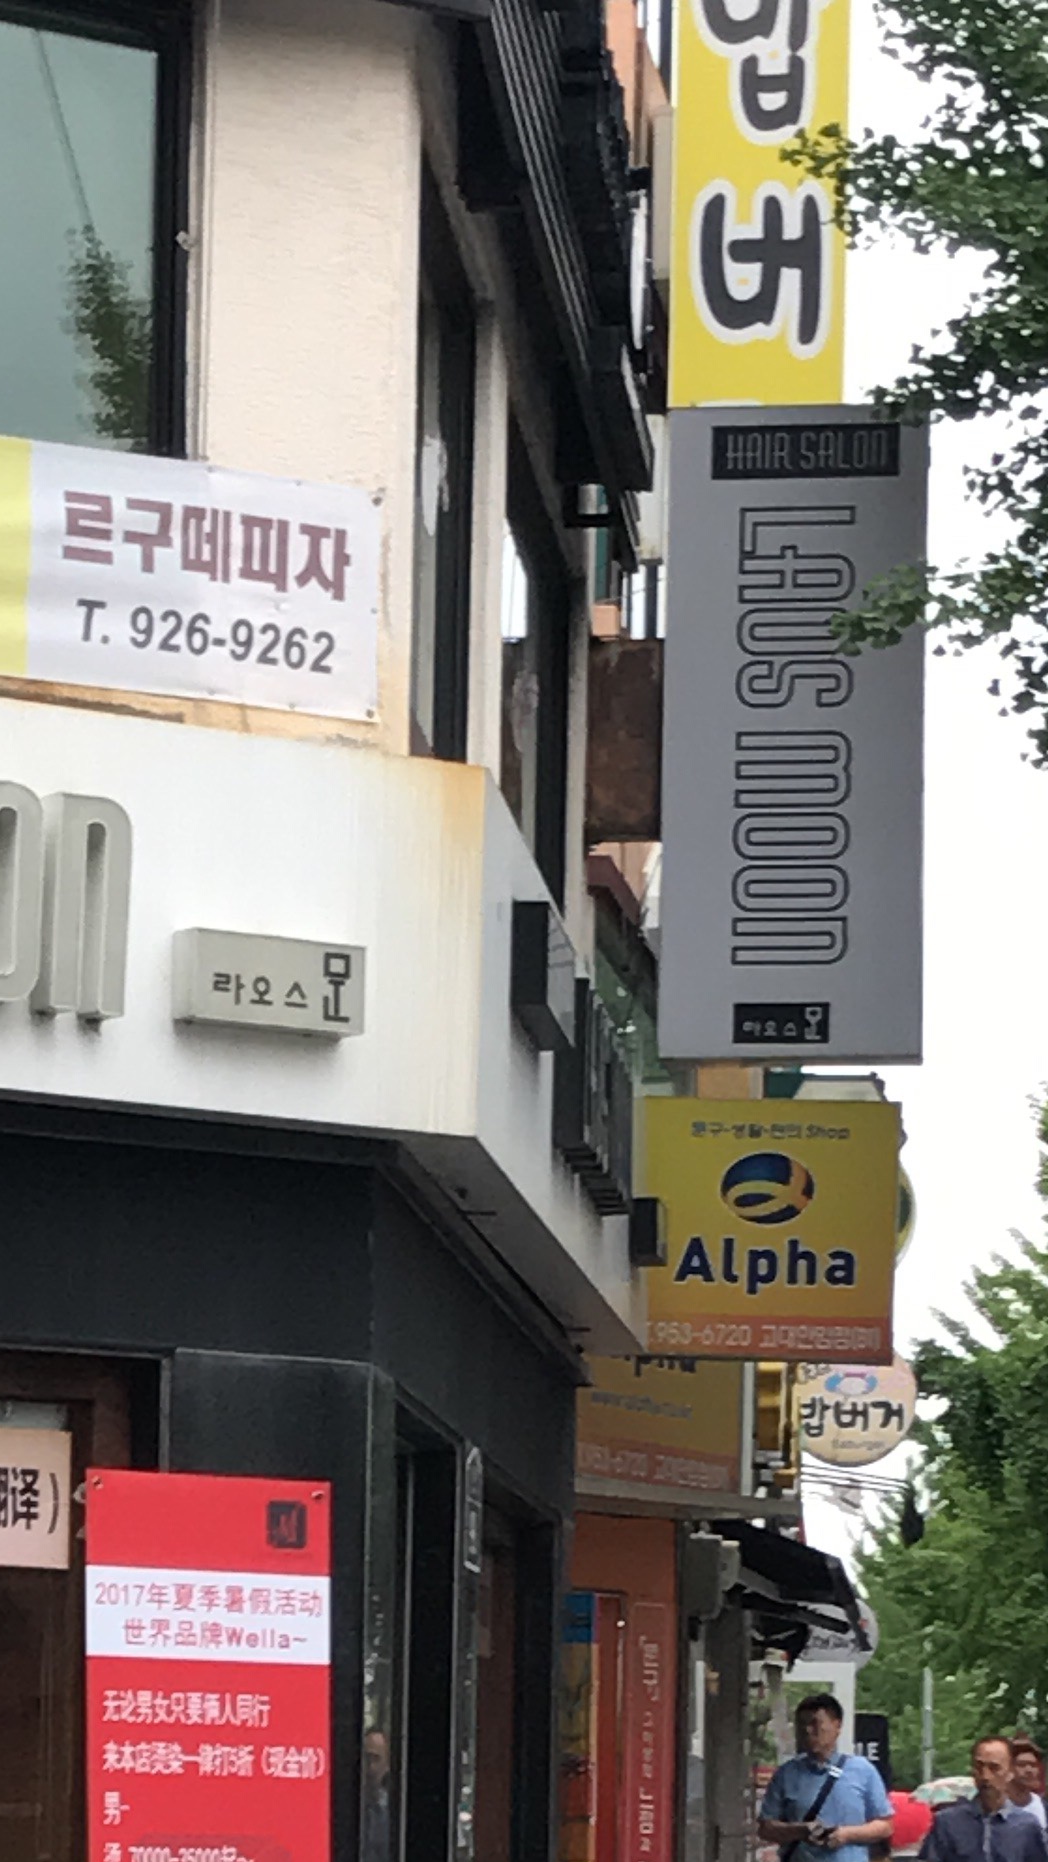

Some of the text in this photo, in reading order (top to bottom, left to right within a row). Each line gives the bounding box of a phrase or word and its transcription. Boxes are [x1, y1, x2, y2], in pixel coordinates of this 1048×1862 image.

[725, 430, 888, 471] HAIR SALON
[61, 490, 351, 600] 르구떼피자
[128, 605, 336, 675] 926-9262
[673, 1236, 858, 1296] Alpha
